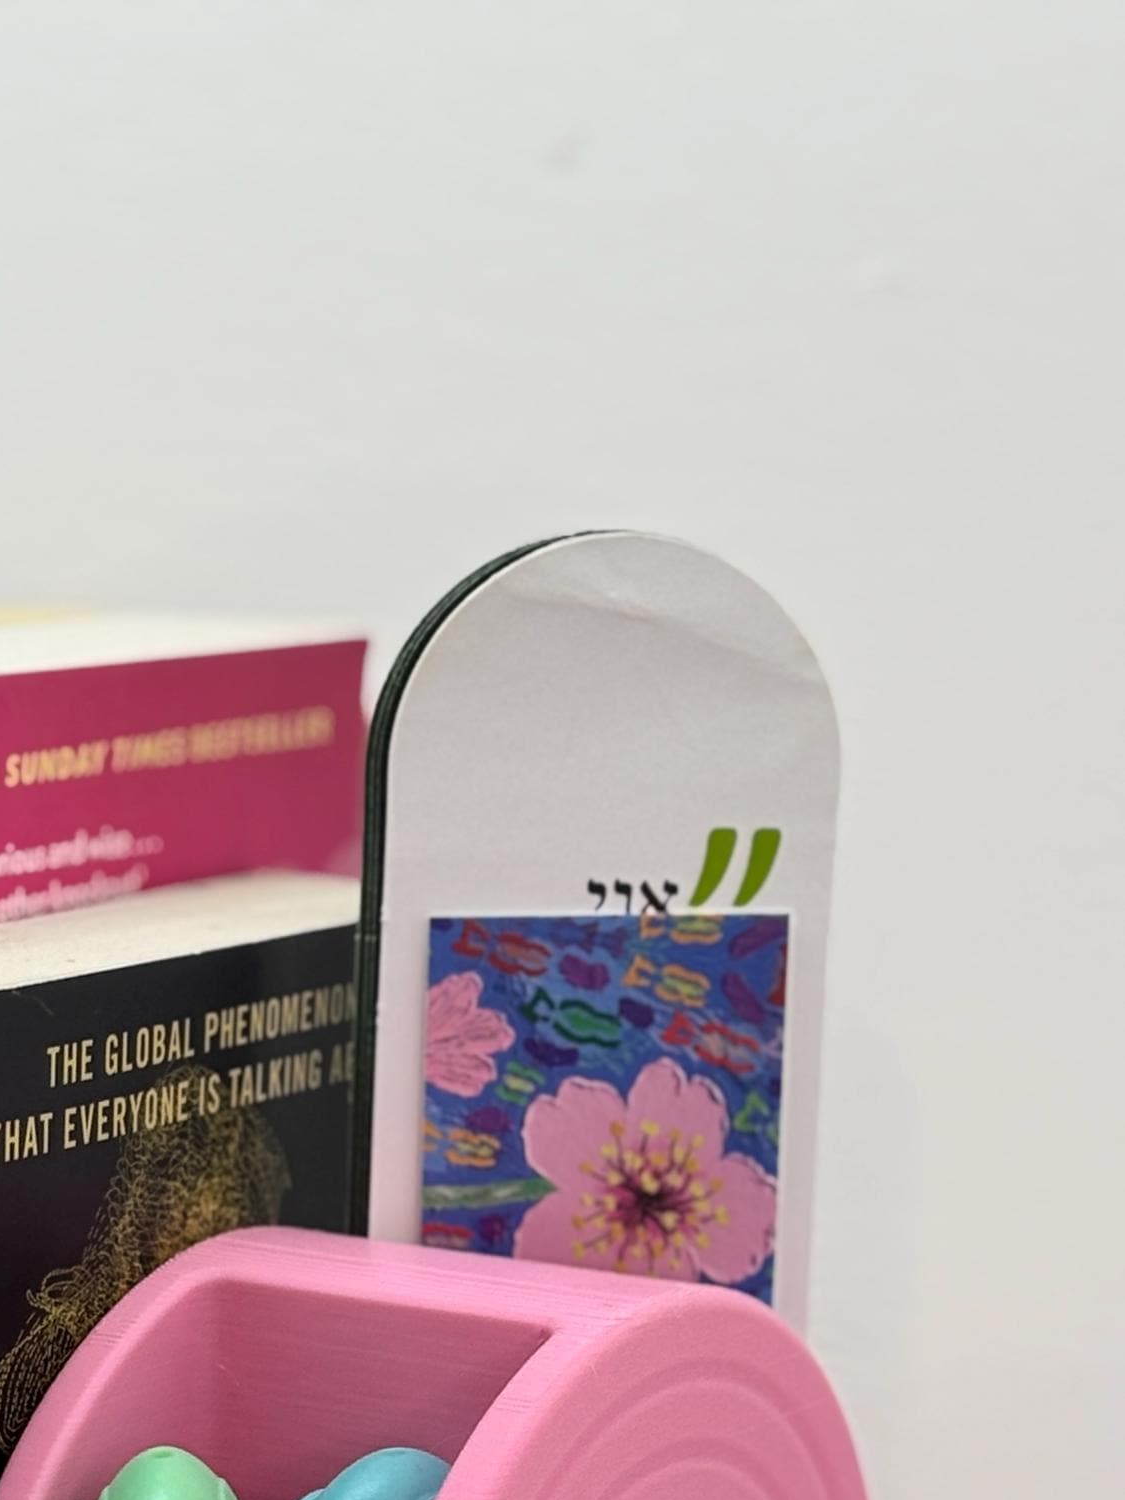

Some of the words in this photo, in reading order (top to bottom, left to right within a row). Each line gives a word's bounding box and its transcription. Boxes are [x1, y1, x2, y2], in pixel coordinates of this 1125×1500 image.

[5, 738, 110, 788] SUNDAY
[47, 1039, 94, 1088] THE
[105, 1017, 195, 1076] GLOBAL
[63, 1081, 189, 1150] EVERYONE
[199, 1072, 221, 1116] IS
[229, 1049, 322, 1108] TALKING
